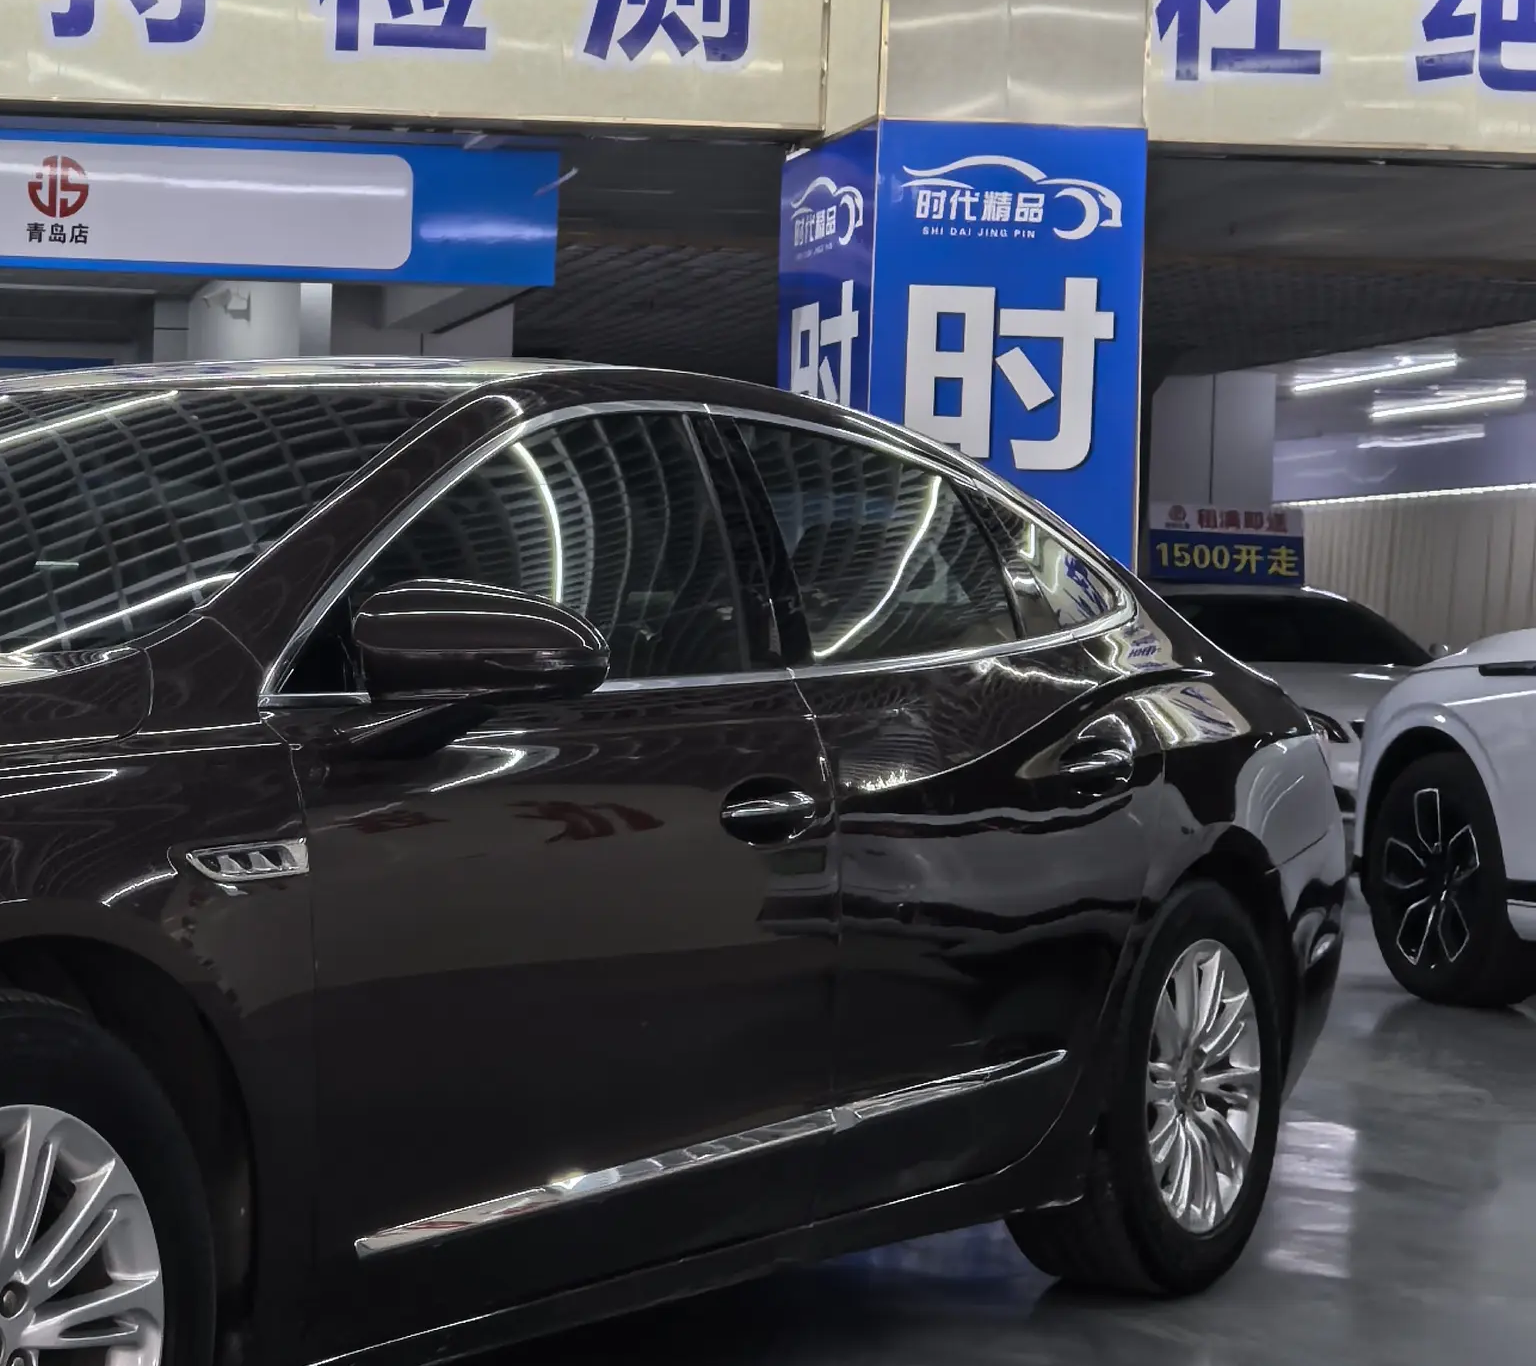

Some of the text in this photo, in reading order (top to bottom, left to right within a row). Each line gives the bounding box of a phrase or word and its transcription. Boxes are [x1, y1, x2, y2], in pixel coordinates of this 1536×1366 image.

[915, 189, 1046, 223] 时代精品
[26, 222, 89, 245] 青岛店
[922, 226, 944, 236] SHI
[950, 227, 972, 237] DAI
[1014, 229, 1036, 239] PIN
[1156, 542, 1299, 577] 1500开走
